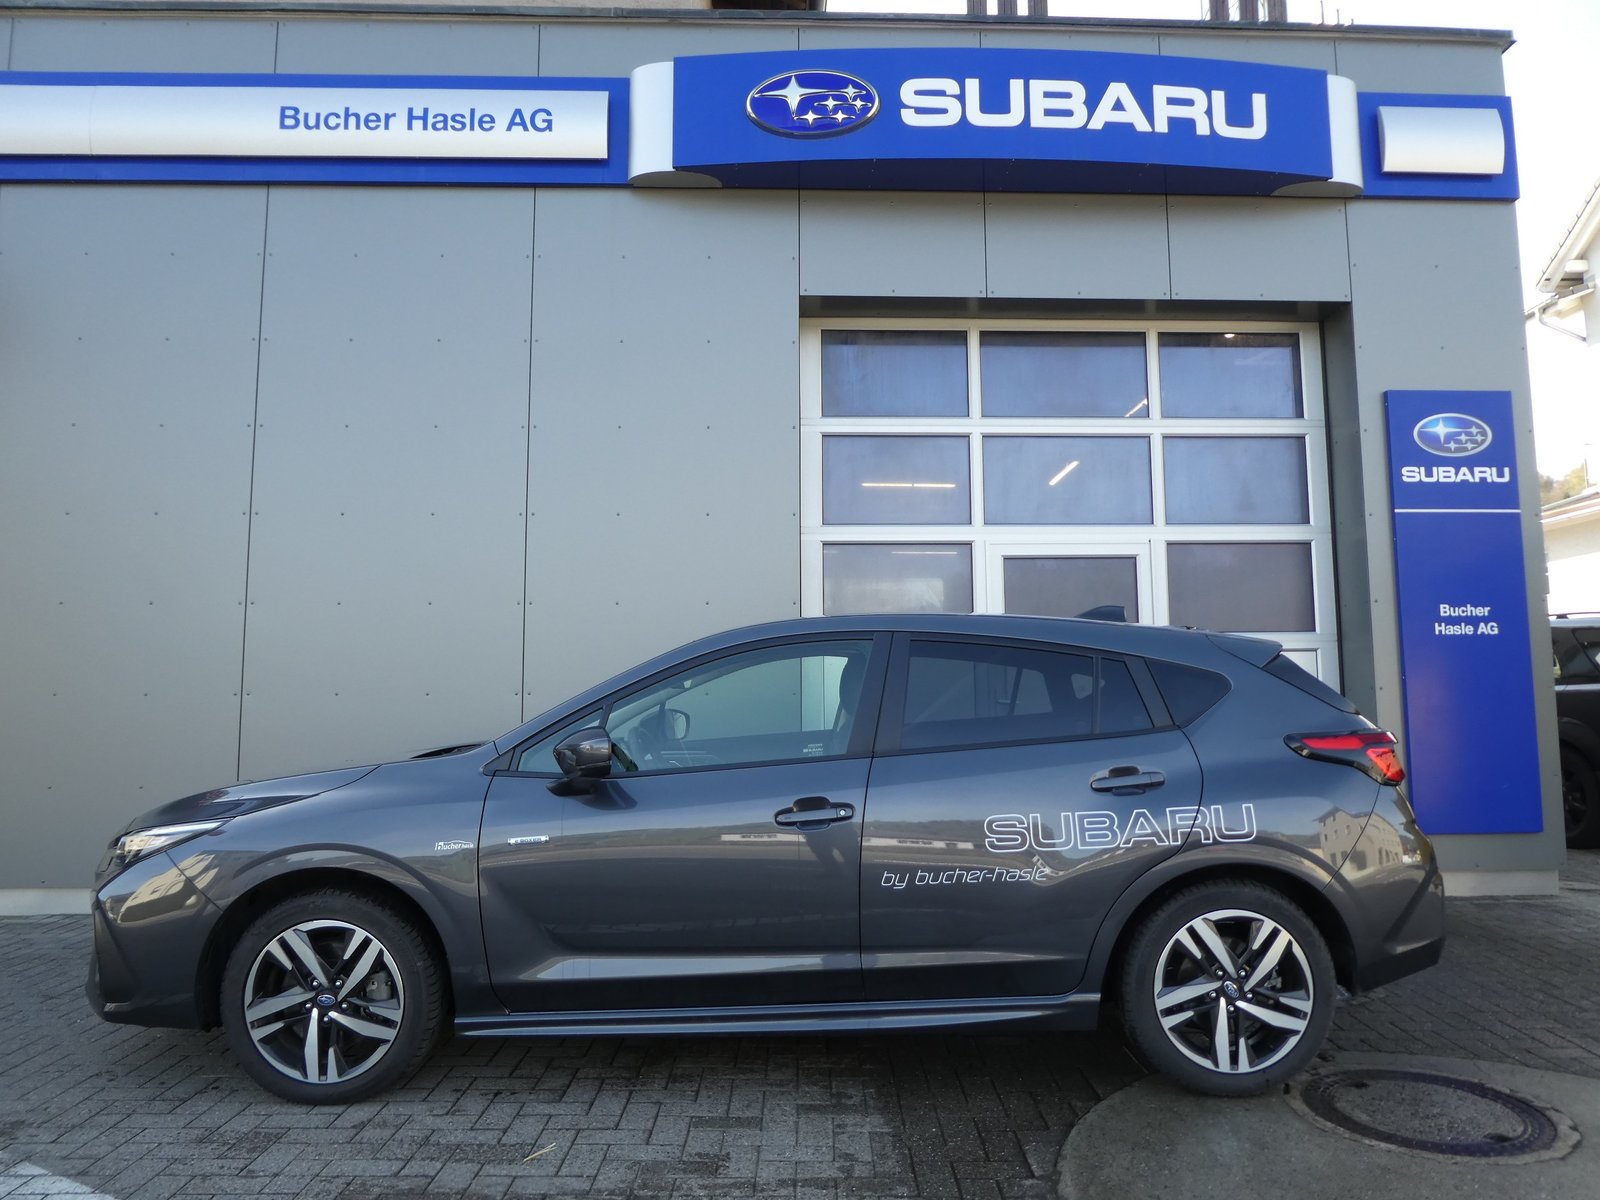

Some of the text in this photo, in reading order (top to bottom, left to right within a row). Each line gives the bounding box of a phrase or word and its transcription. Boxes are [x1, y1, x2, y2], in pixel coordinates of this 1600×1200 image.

[279, 105, 553, 133] Bucher Hasle AG
[899, 77, 1268, 140] SUBARU
[1401, 466, 1511, 483] SUBARU
[1439, 603, 1492, 617] Bucher
[1434, 621, 1499, 635] Hasle AG
[984, 803, 1257, 852] SUBARU
[881, 866, 1049, 889] by bucher-hasle
